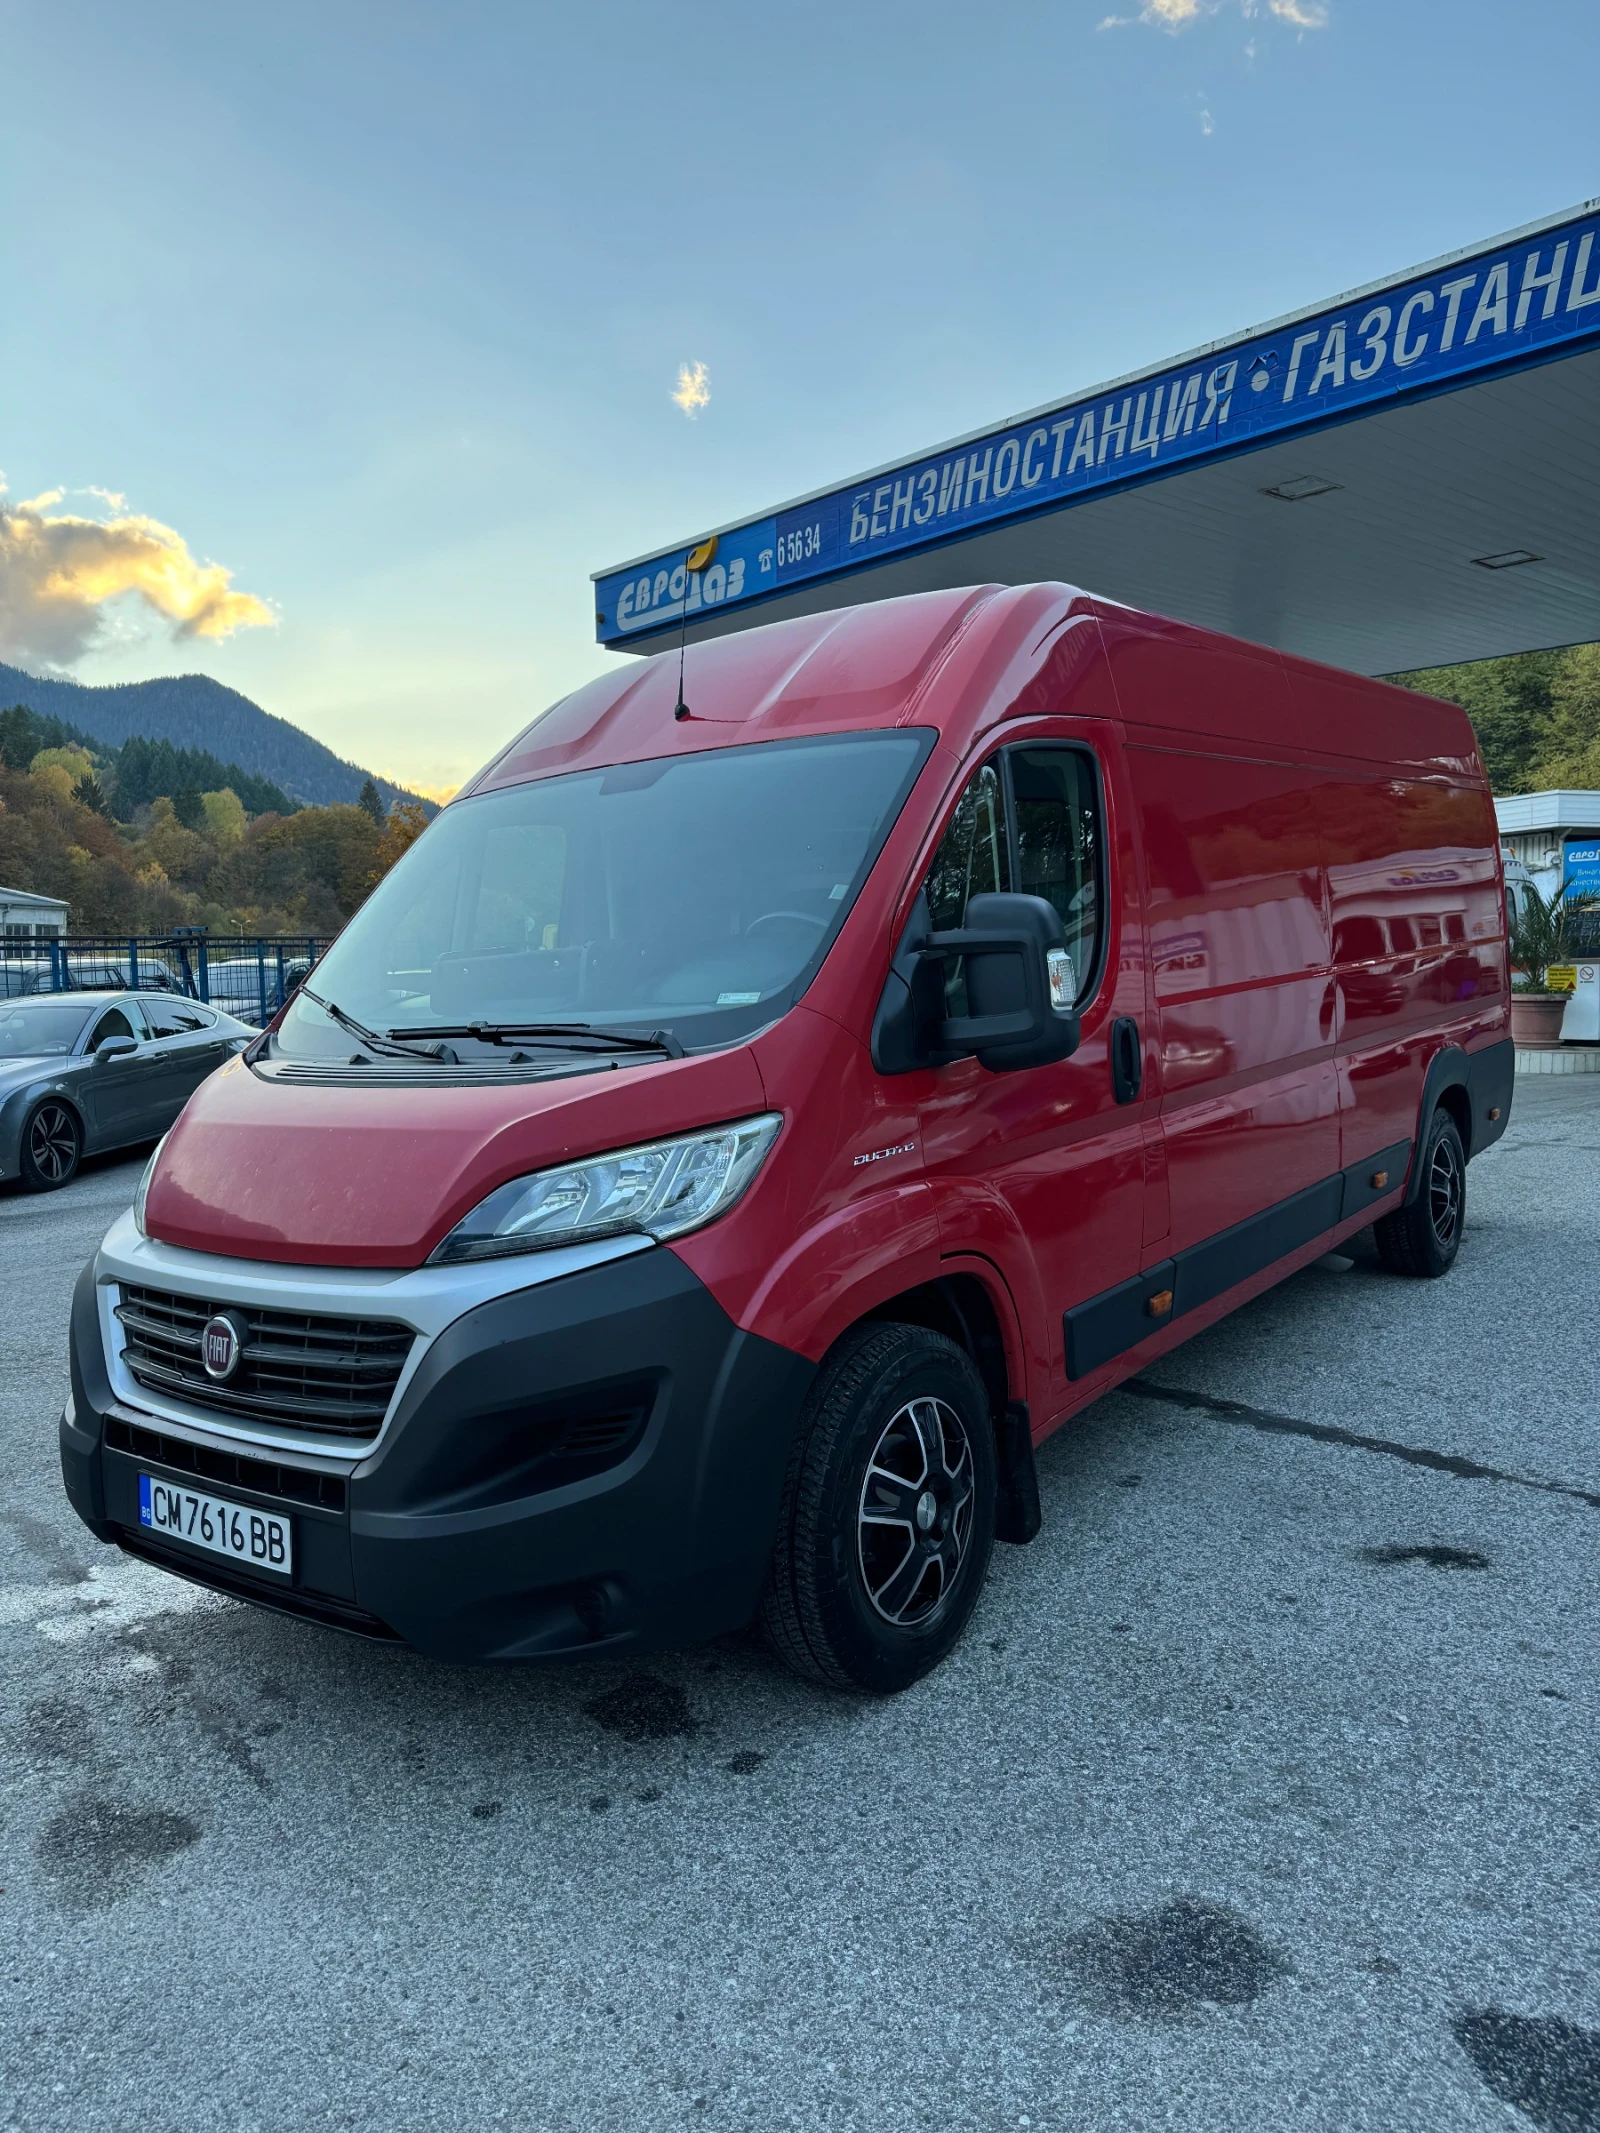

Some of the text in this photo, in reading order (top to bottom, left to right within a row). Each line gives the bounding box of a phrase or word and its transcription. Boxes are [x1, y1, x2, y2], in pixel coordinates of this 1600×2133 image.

[849, 359, 1239, 545] БЕНЗИНОСТАНЦИЯ
[853, 1142, 915, 1166] DUCATO
[208, 1334, 230, 1364] FIAT
[141, 1505, 151, 1520] BG
